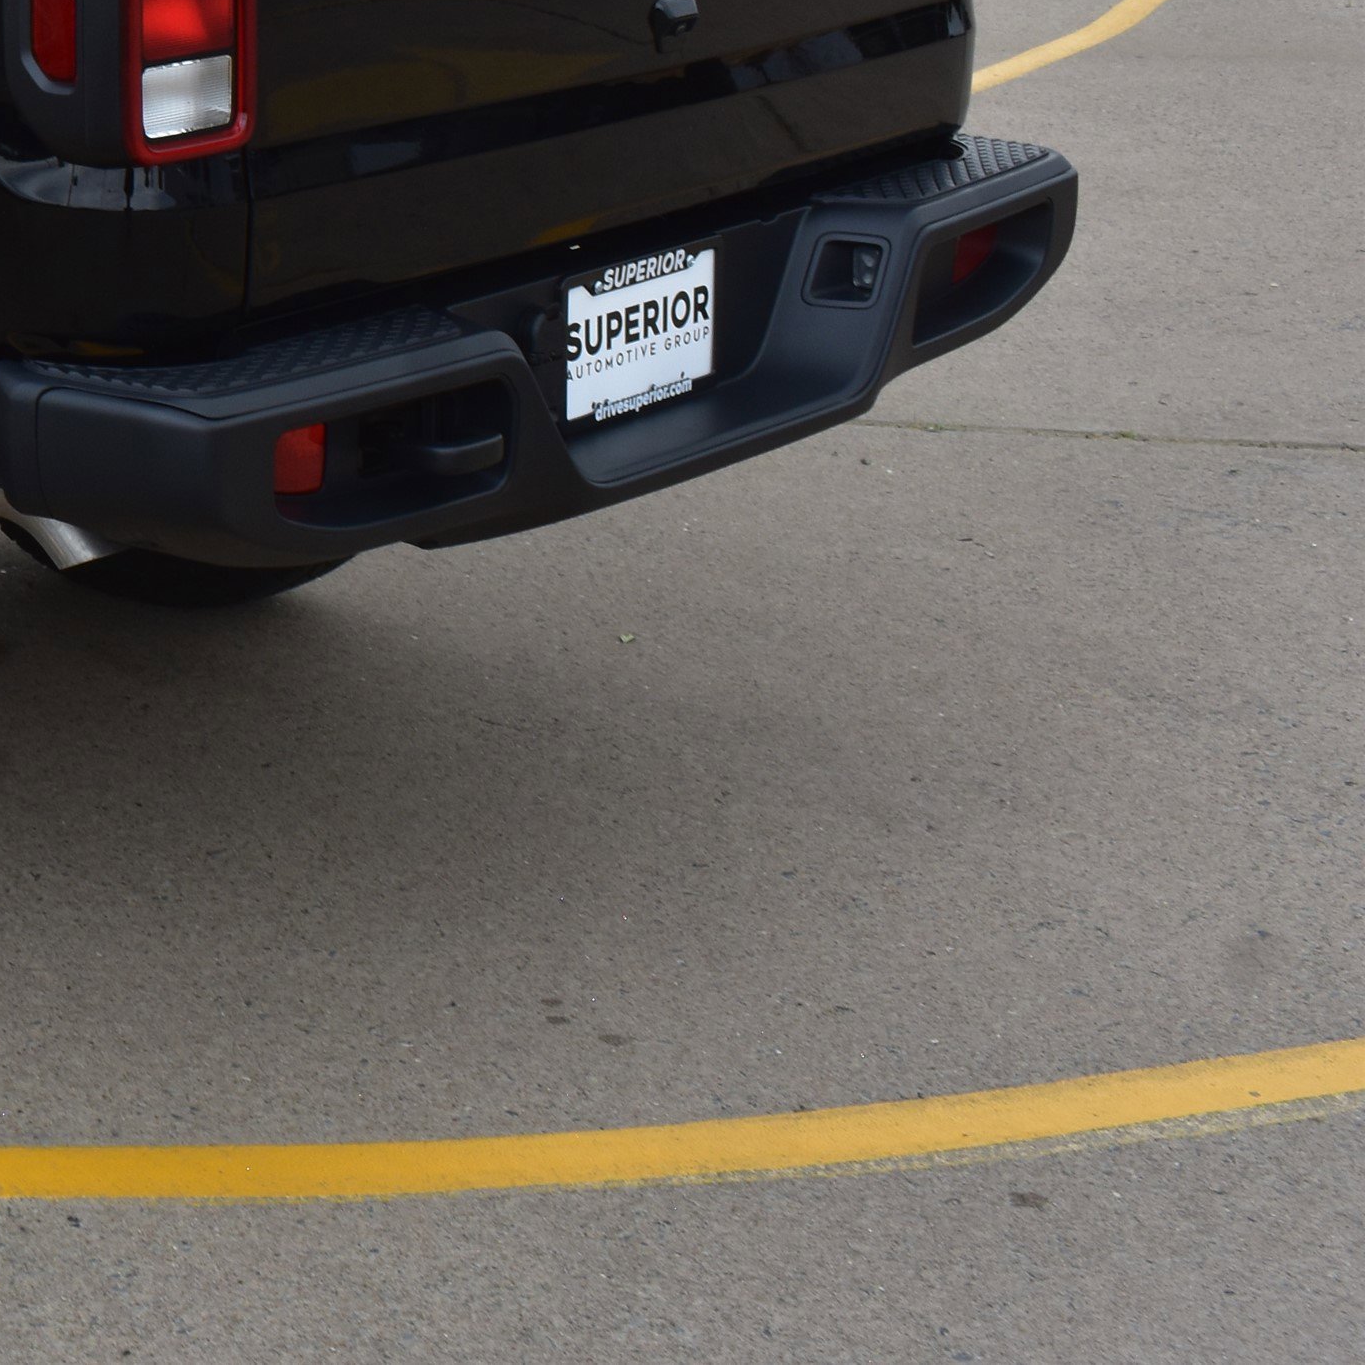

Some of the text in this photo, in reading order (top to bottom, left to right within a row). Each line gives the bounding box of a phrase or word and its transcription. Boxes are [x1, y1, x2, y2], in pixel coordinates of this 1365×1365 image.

[603, 248, 687, 292] SUPERIOR
[566, 285, 709, 361] SUPERIOR
[566, 326, 710, 382] AUTOMOTIVE GROUP
[595, 377, 692, 422] drivesuperior.com
